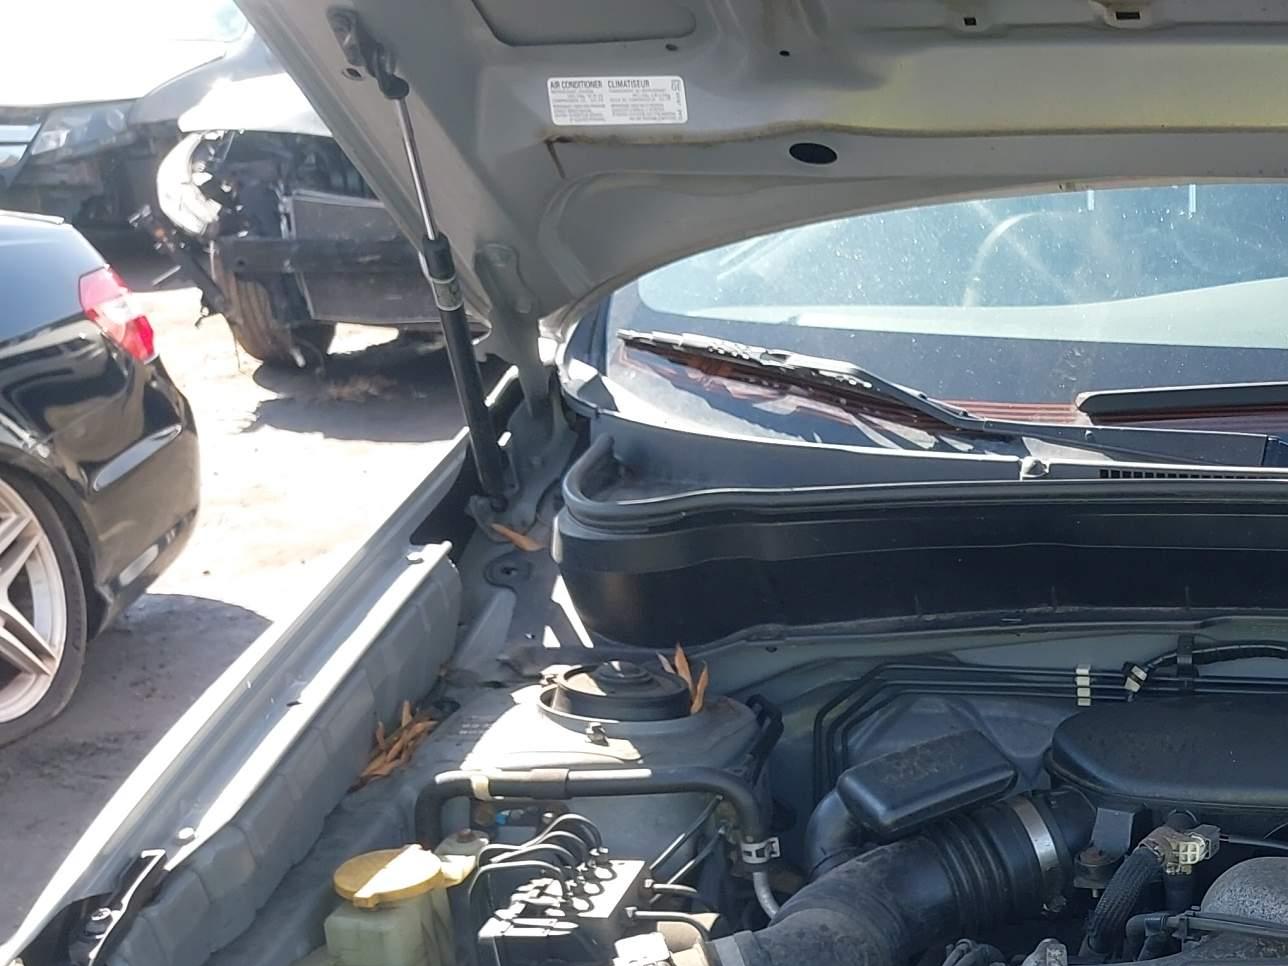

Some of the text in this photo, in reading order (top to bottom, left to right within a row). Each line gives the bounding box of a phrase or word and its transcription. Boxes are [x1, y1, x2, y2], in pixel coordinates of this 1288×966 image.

[550, 80, 603, 89] AIR CONDITIONER
[607, 79, 650, 88] CLIMATISEUR
